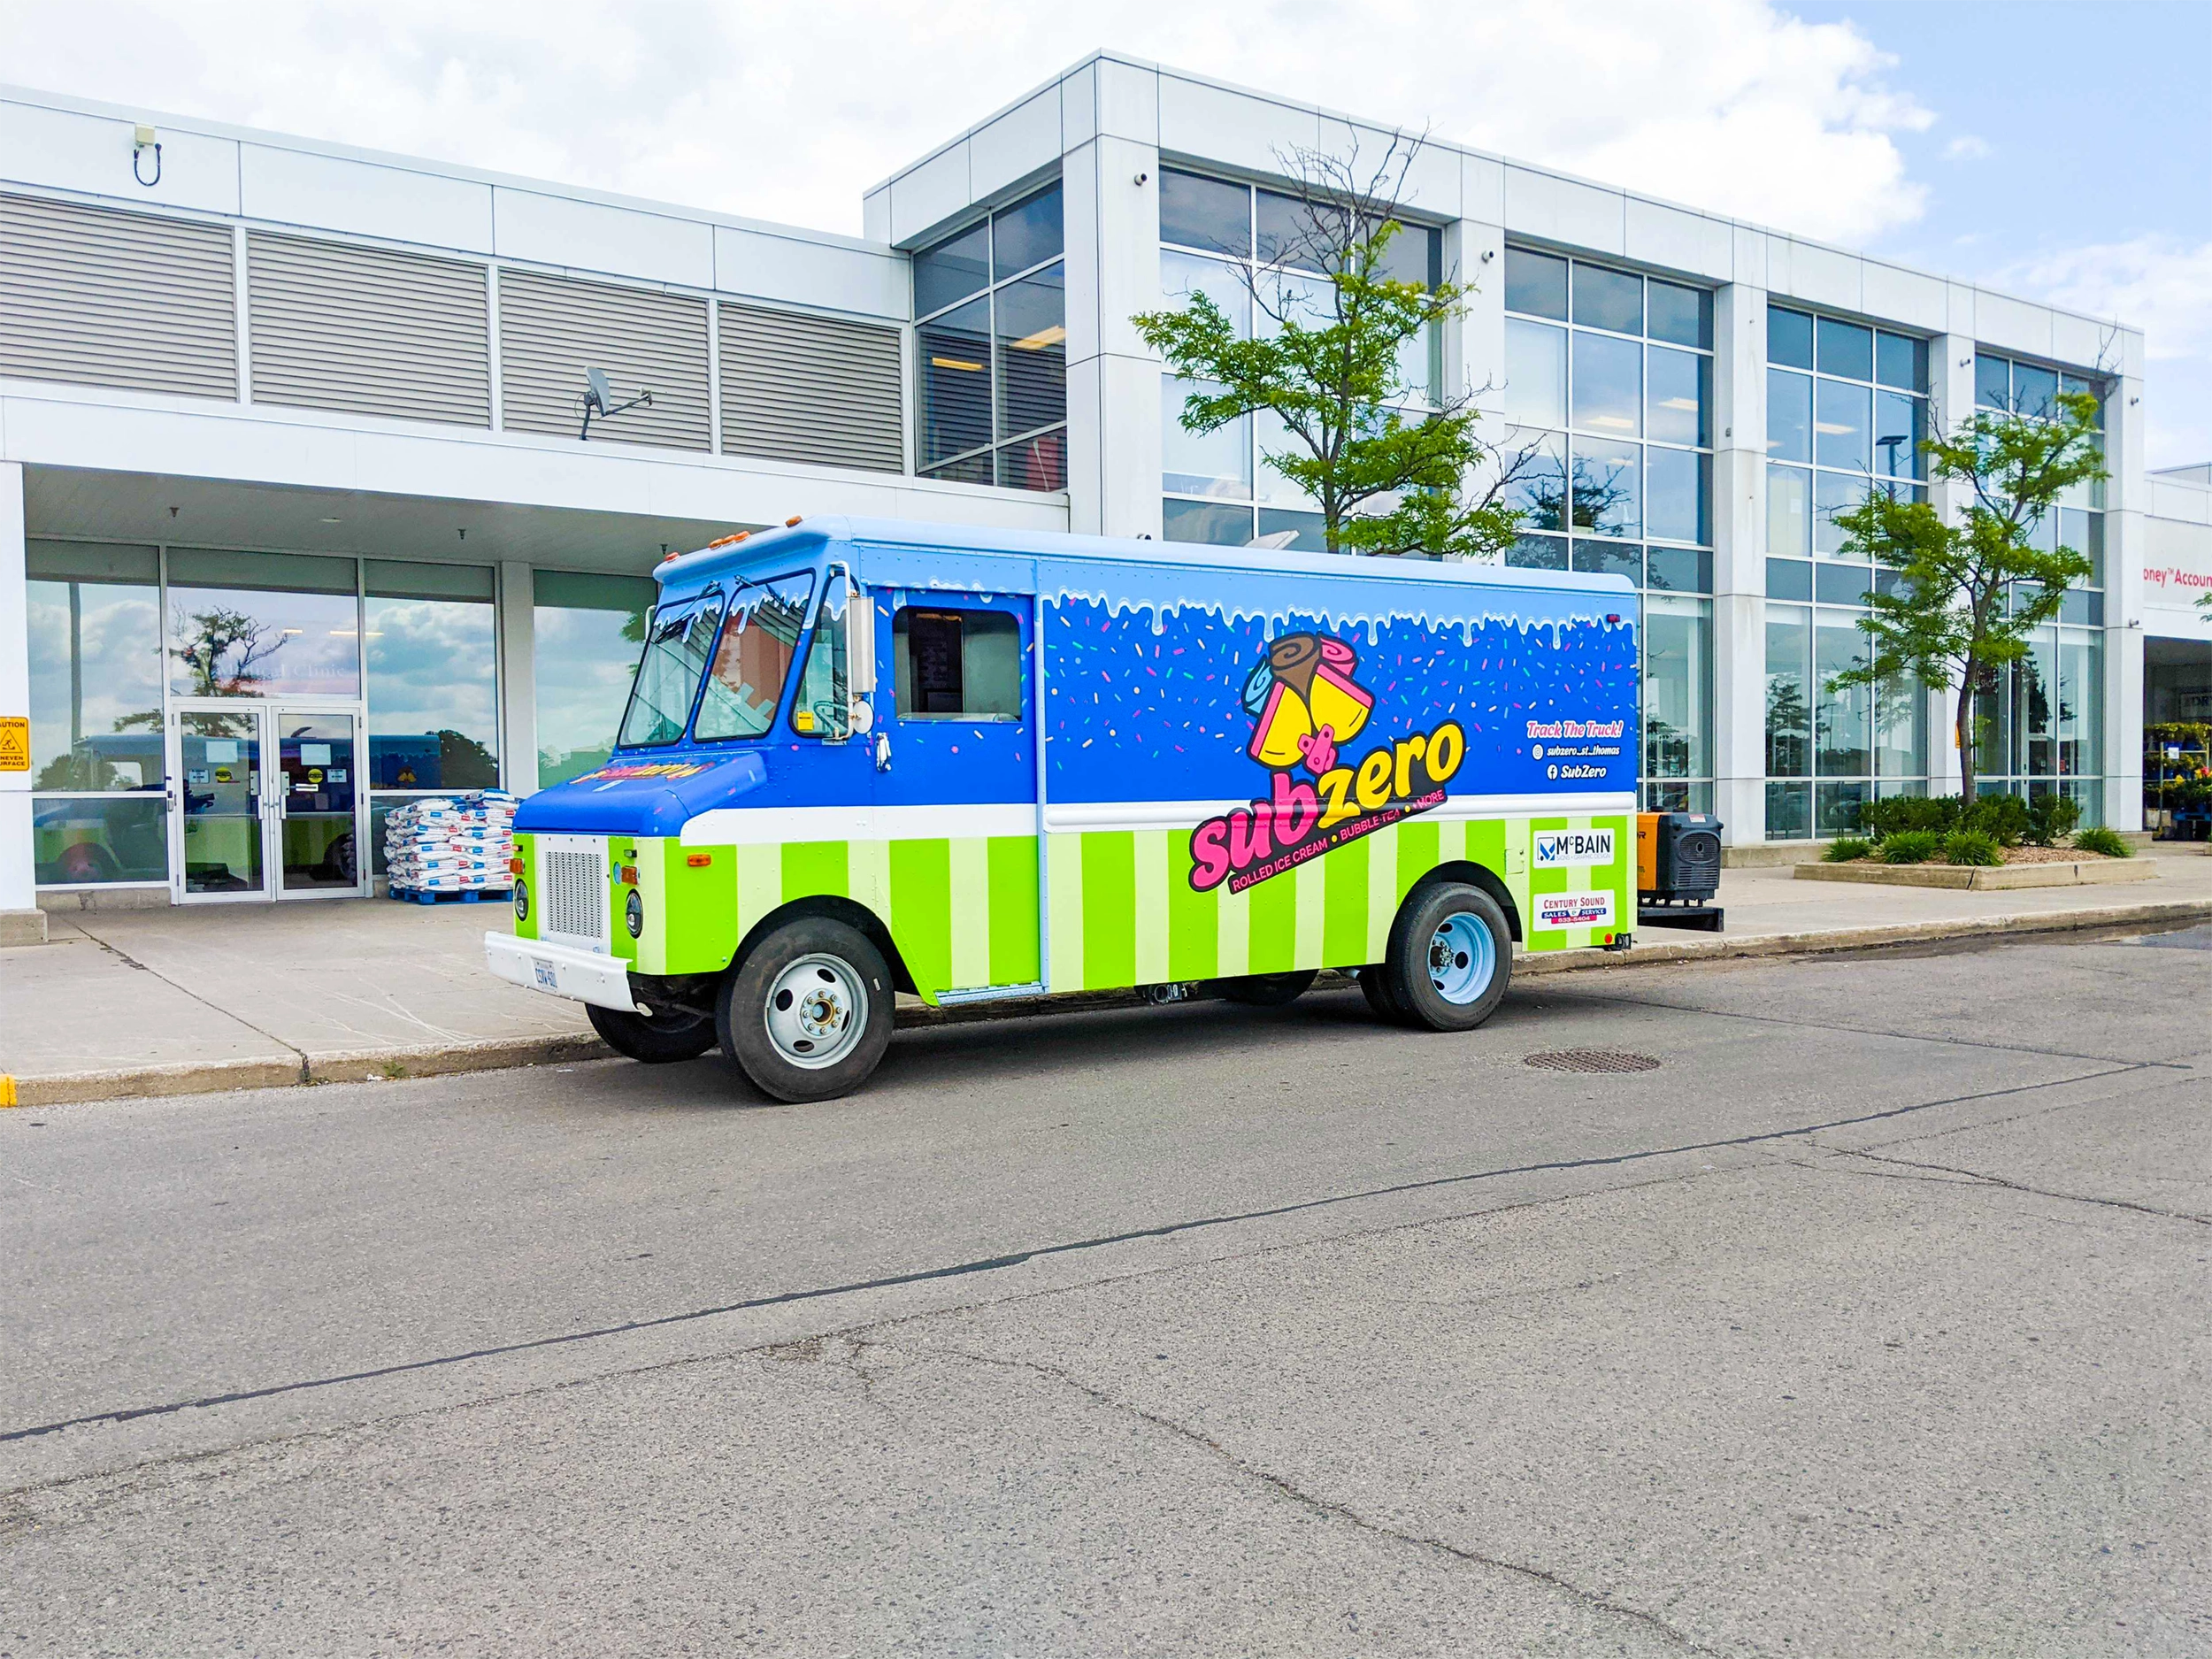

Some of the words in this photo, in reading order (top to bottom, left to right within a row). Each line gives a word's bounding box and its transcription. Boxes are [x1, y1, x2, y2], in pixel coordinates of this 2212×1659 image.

[294, 663, 345, 678] Clinic
[1527, 720, 1563, 738] Track
[1563, 720, 1586, 738] The
[1586, 720, 1624, 738] Truck!
[1547, 745, 1620, 757] subzero_st_thomas
[1560, 764, 1607, 779] SubZero
[1232, 864, 1273, 892] ROLLED
[1274, 855, 1292, 872] ICE
[1292, 837, 1328, 863] CREAM
[1340, 815, 1380, 841] BUBBLE
[1380, 808, 1402, 823] TEA
[1417, 789, 1445, 809] MORE
[1556, 834, 1610, 855] McBAIN
[1543, 898, 1578, 910] CENTURY
[1580, 896, 1606, 907] SOUND
